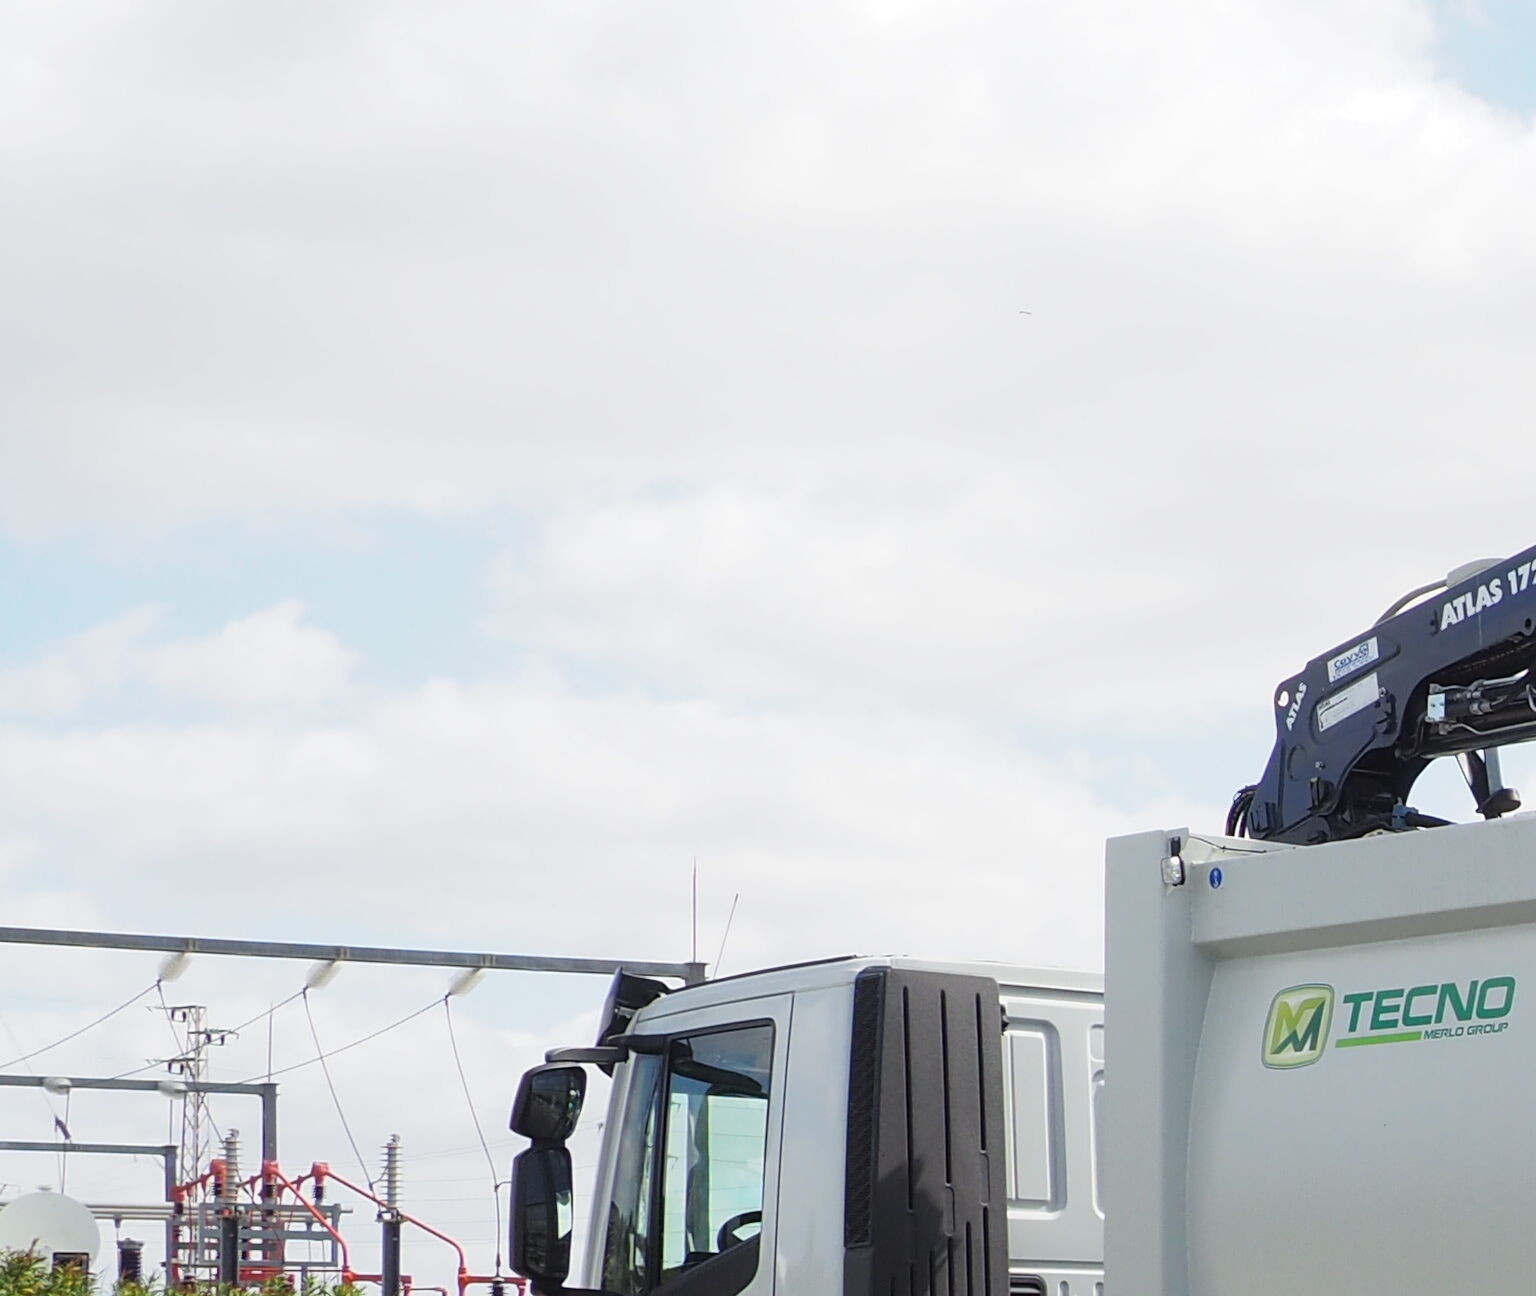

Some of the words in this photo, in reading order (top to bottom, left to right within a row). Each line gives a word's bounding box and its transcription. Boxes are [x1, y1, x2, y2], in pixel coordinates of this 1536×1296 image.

[1440, 578, 1503, 631] ATLAS
[1286, 682, 1307, 731] ATLAS
[1343, 976, 1516, 1033] TECNO
[1423, 1026, 1464, 1040] MERLO
[1467, 1022, 1509, 1036] GROUP
